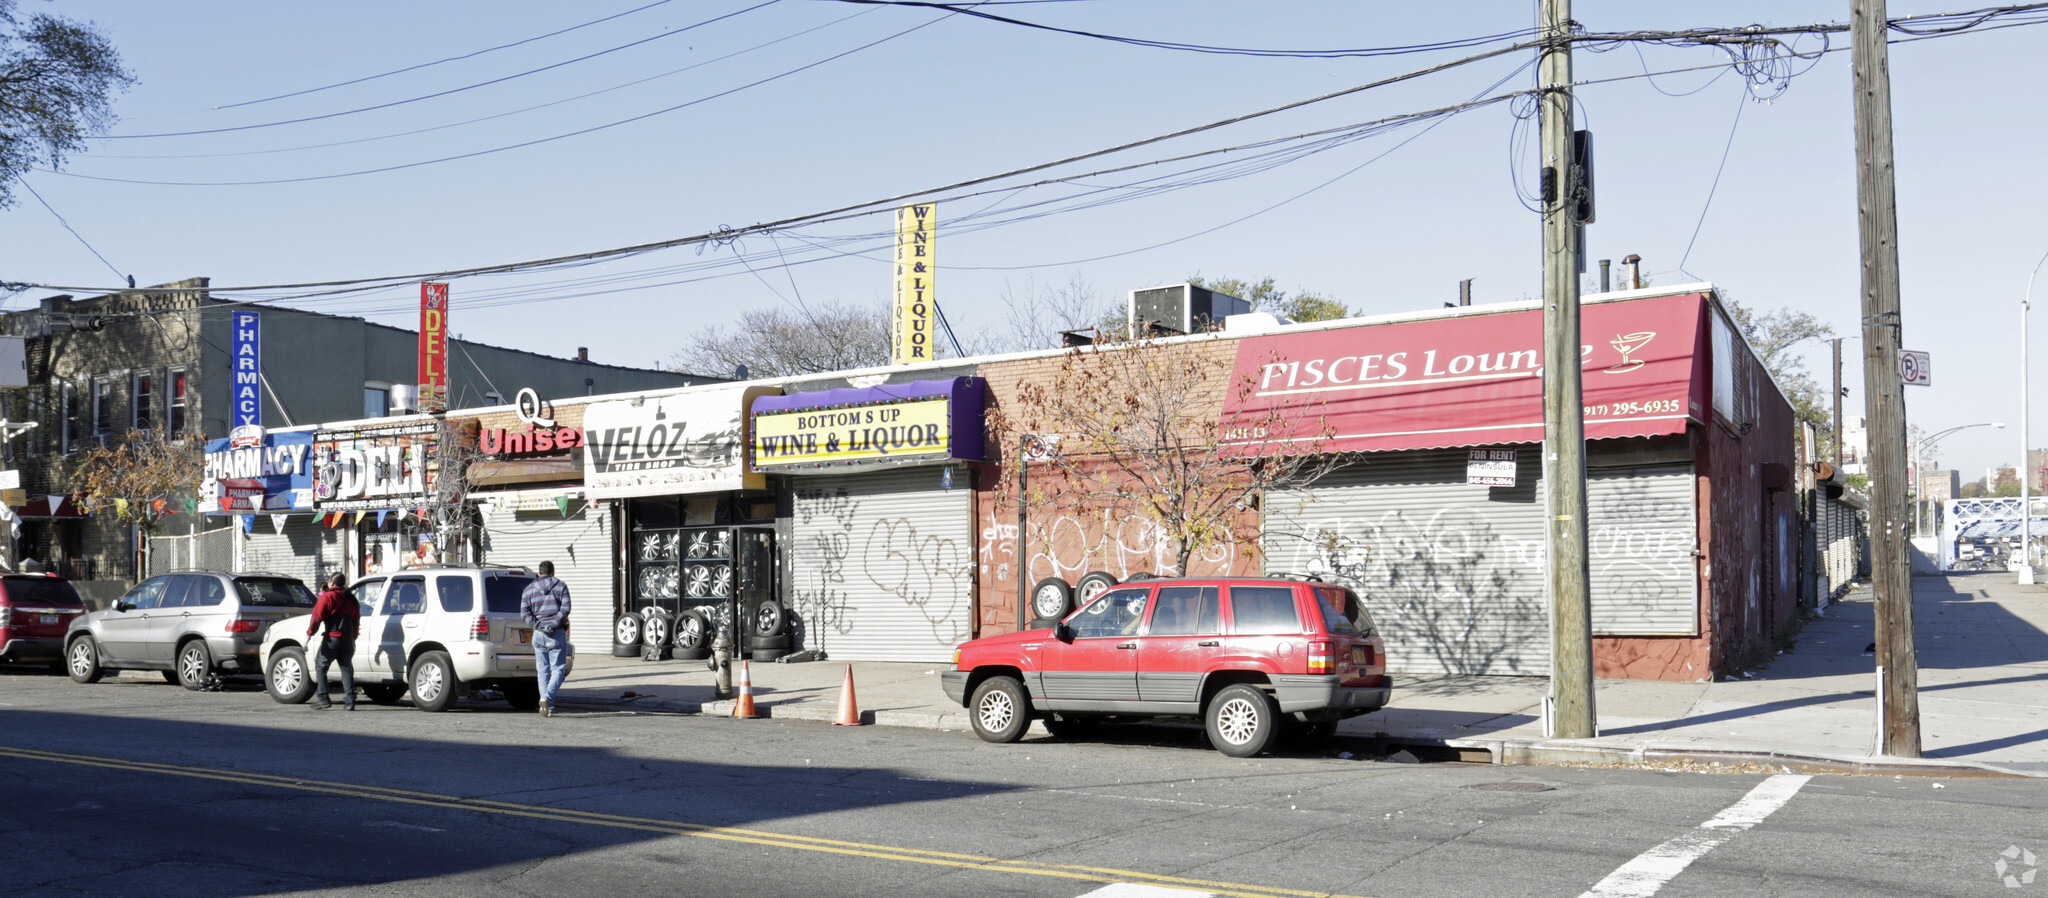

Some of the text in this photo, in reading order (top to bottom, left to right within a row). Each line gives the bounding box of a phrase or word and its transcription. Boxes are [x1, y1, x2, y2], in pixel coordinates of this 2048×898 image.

[911, 206, 930, 358] WINE & LIQUOR
[237, 315, 257, 426] PHARMACY
[425, 309, 441, 399] DELI
[1260, 344, 1594, 390] PISCES Loune
[515, 387, 554, 428] Q
[880, 408, 901, 423] UP
[1583, 404, 1609, 416] 917)
[1612, 399, 1680, 416] 295-6935
[586, 421, 687, 473] VELOZ
[760, 423, 941, 458] WINE & LIQUOR
[1469, 450, 1515, 461] FOR RENT
[204, 443, 308, 480] PHARMACY
[335, 443, 425, 500] DELI
[614, 460, 677, 472] TIRE SHOP
[1469, 462, 1514, 471] PENINSULA
[228, 488, 264, 498] PHARMACY
